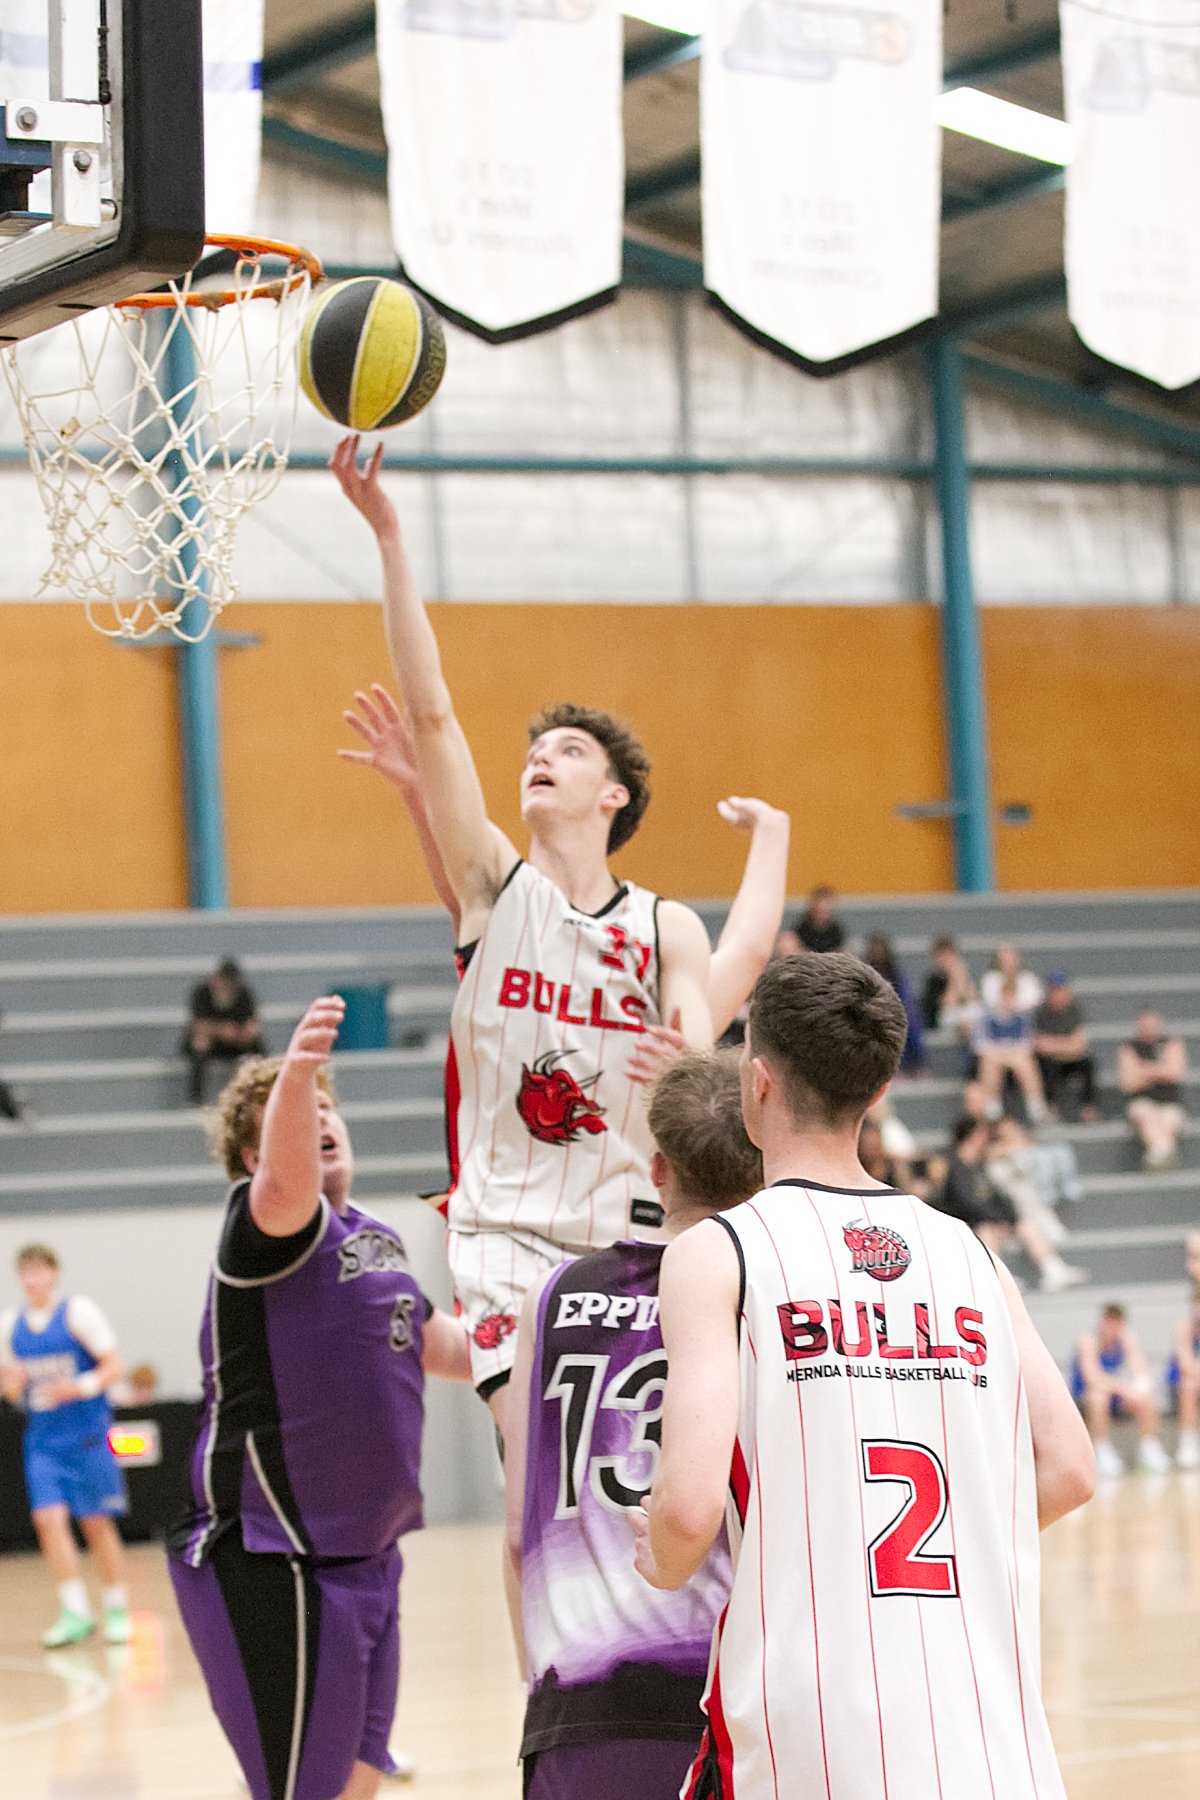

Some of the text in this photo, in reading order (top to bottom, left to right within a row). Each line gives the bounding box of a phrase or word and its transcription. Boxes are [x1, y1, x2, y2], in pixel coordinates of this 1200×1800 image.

[499, 967, 648, 1034] BULLS
[849, 1248, 912, 1273] BULLS
[553, 1292, 660, 1331] EPPI
[777, 1299, 987, 1366] BULLS
[786, 1365, 842, 1383] MERNDA
[846, 1365, 882, 1379] BULLS
[885, 1367, 967, 1381] BASKETBALL
[543, 1348, 668, 1520] 13
[861, 1438, 961, 1598] 2
